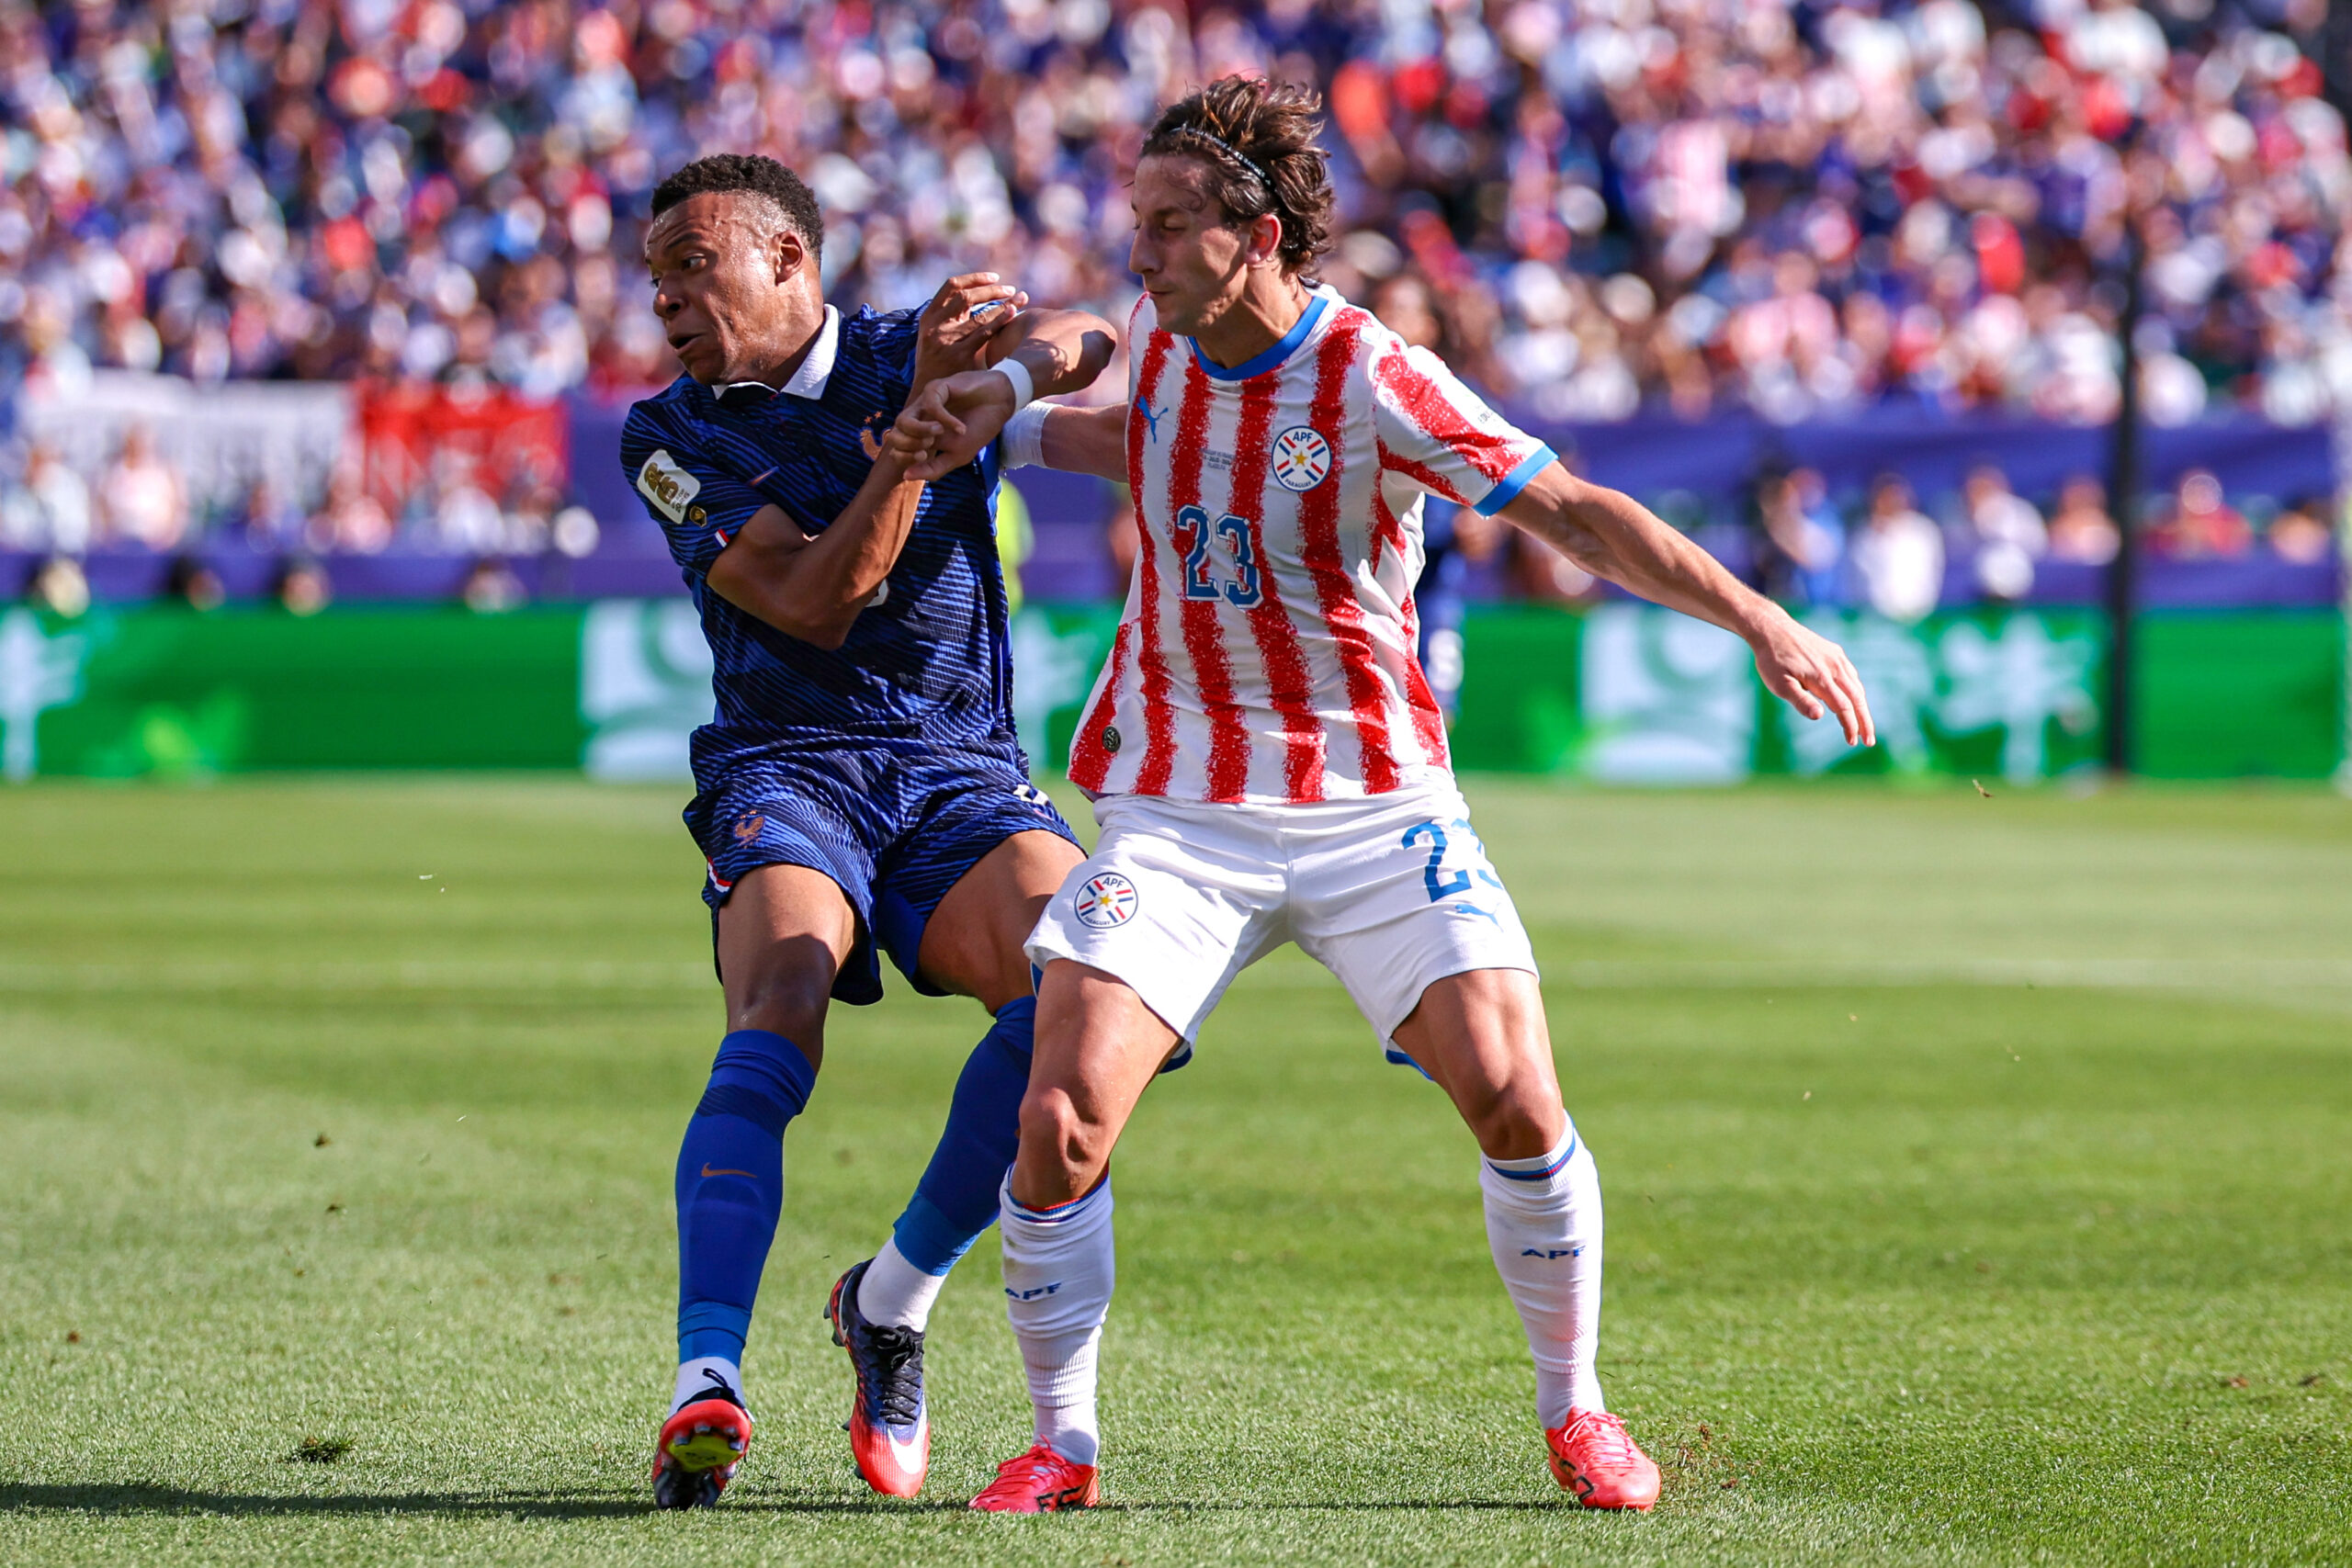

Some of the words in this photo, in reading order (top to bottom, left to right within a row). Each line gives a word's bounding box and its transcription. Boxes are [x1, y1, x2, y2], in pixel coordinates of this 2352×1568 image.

[1293, 431, 1313, 442] APF
[1285, 479, 1312, 489] PARAGUAY
[1177, 504, 1264, 609] 23
[1102, 876, 1125, 888] APF
[1521, 1245, 1586, 1259] APF
[1004, 1282, 1062, 1300] APF
